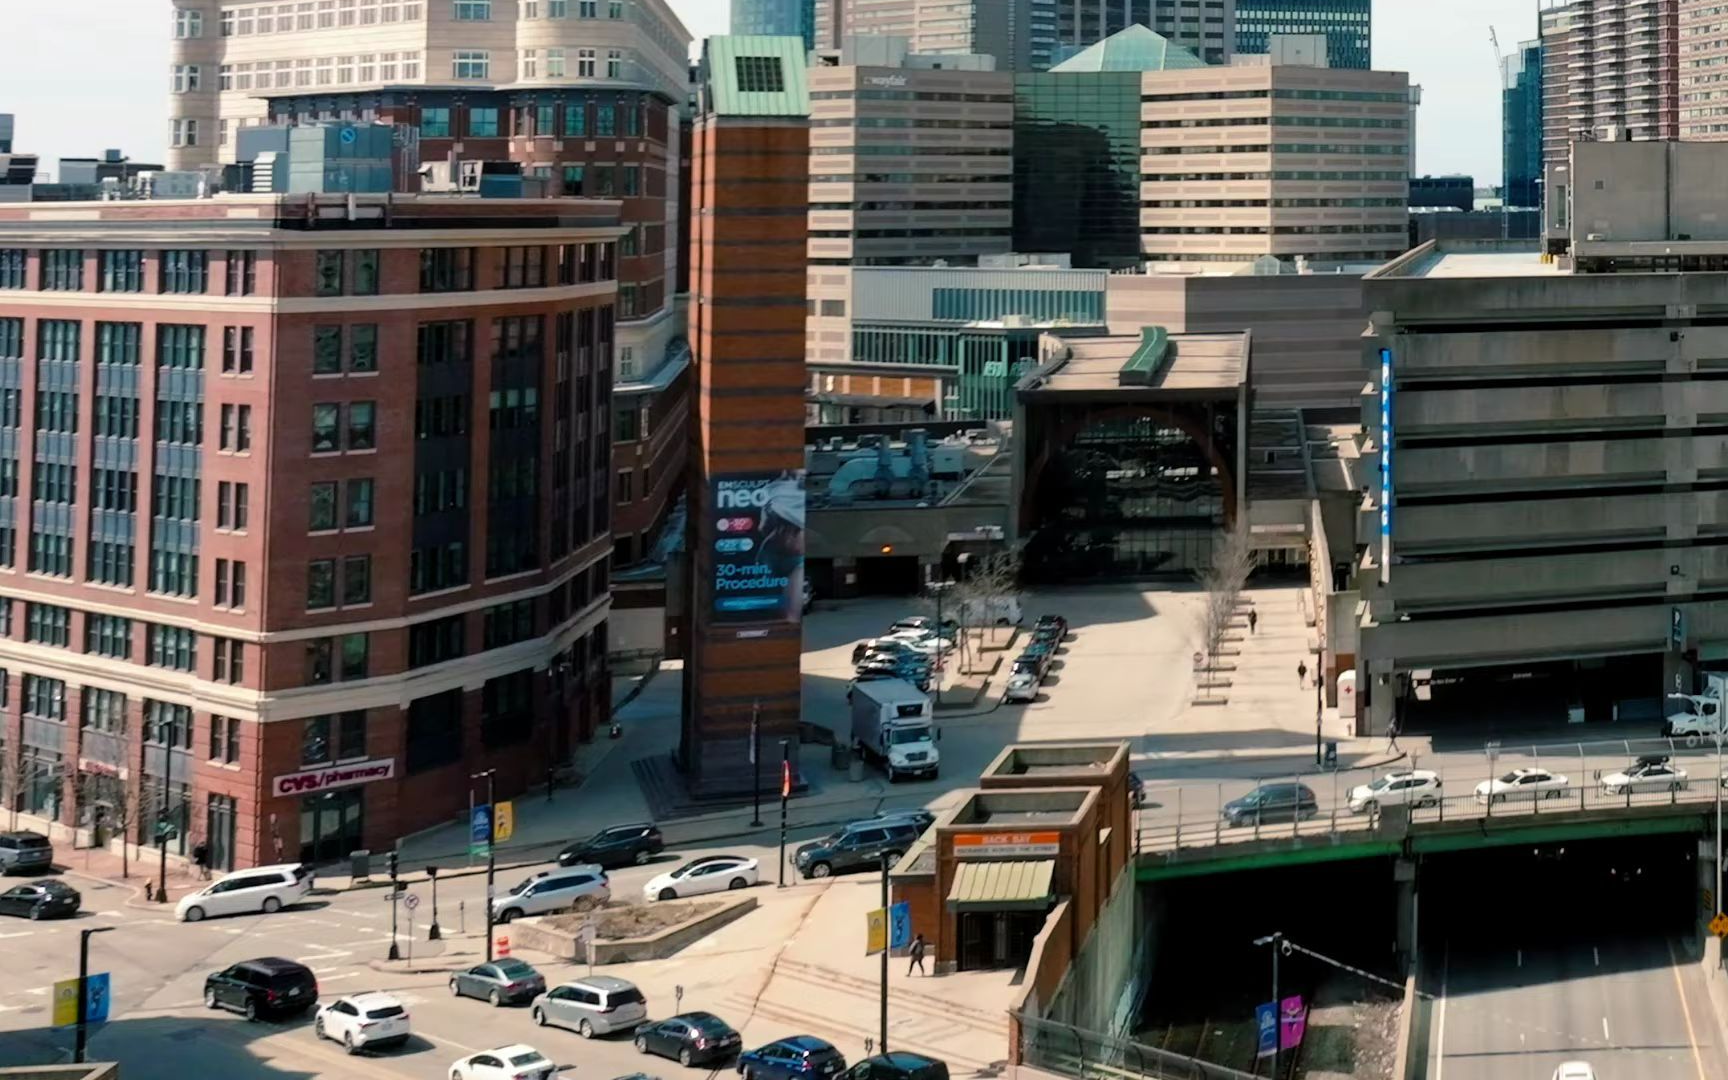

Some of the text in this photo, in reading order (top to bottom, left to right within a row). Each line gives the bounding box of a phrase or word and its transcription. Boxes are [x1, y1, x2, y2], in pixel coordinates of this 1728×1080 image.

[871, 75, 906, 88] wayfair
[717, 488, 768, 508] neo
[715, 562, 772, 577] 30-min.
[715, 575, 789, 590] Procedure
